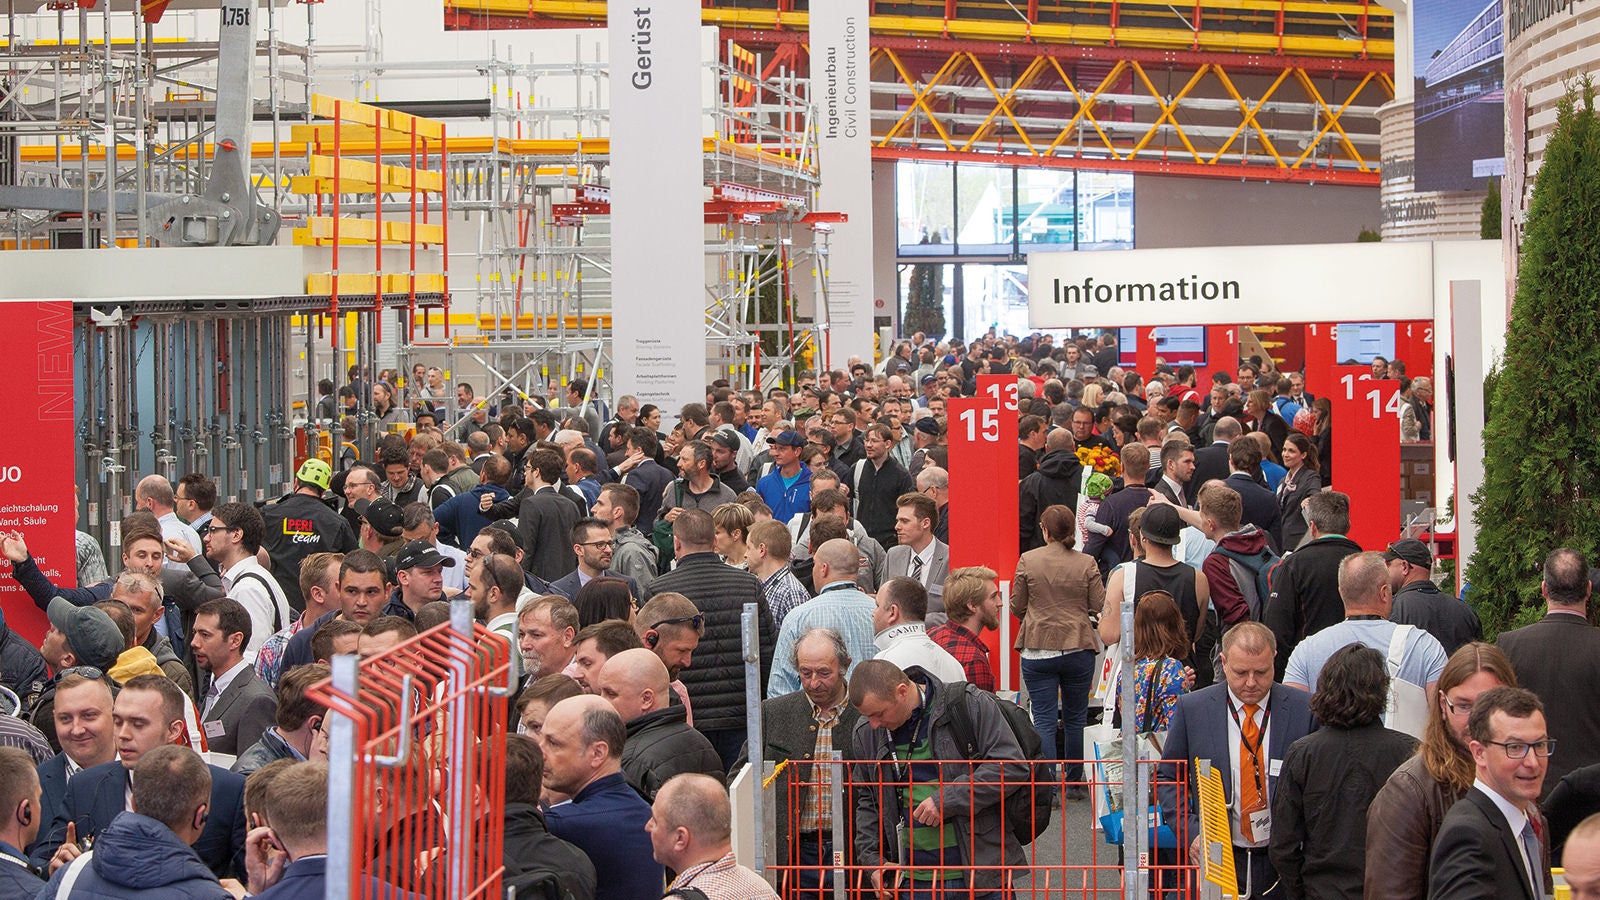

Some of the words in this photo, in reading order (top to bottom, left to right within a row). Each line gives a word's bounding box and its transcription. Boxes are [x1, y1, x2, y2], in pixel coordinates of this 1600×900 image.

[222, 5, 250, 27] 1,75t
[632, 7, 652, 90] Gerüst
[844, 17, 856, 105] Construction
[825, 47, 840, 138] Ingenieurbau
[844, 109, 857, 138] Civil
[1053, 275, 1240, 304] Information
[1226, 329, 1234, 344] 1
[1424, 328, 1432, 342] 2
[986, 383, 1018, 410] 13
[1340, 374, 1372, 400] 1
[1366, 389, 1400, 419] 14
[960, 409, 999, 442] 15
[0, 503, 59, 513] eichtschalung
[23, 516, 47, 526] Säule
[287, 519, 313, 532] PERI
[292, 530, 320, 544] team
[888, 625, 919, 639] CAMP
